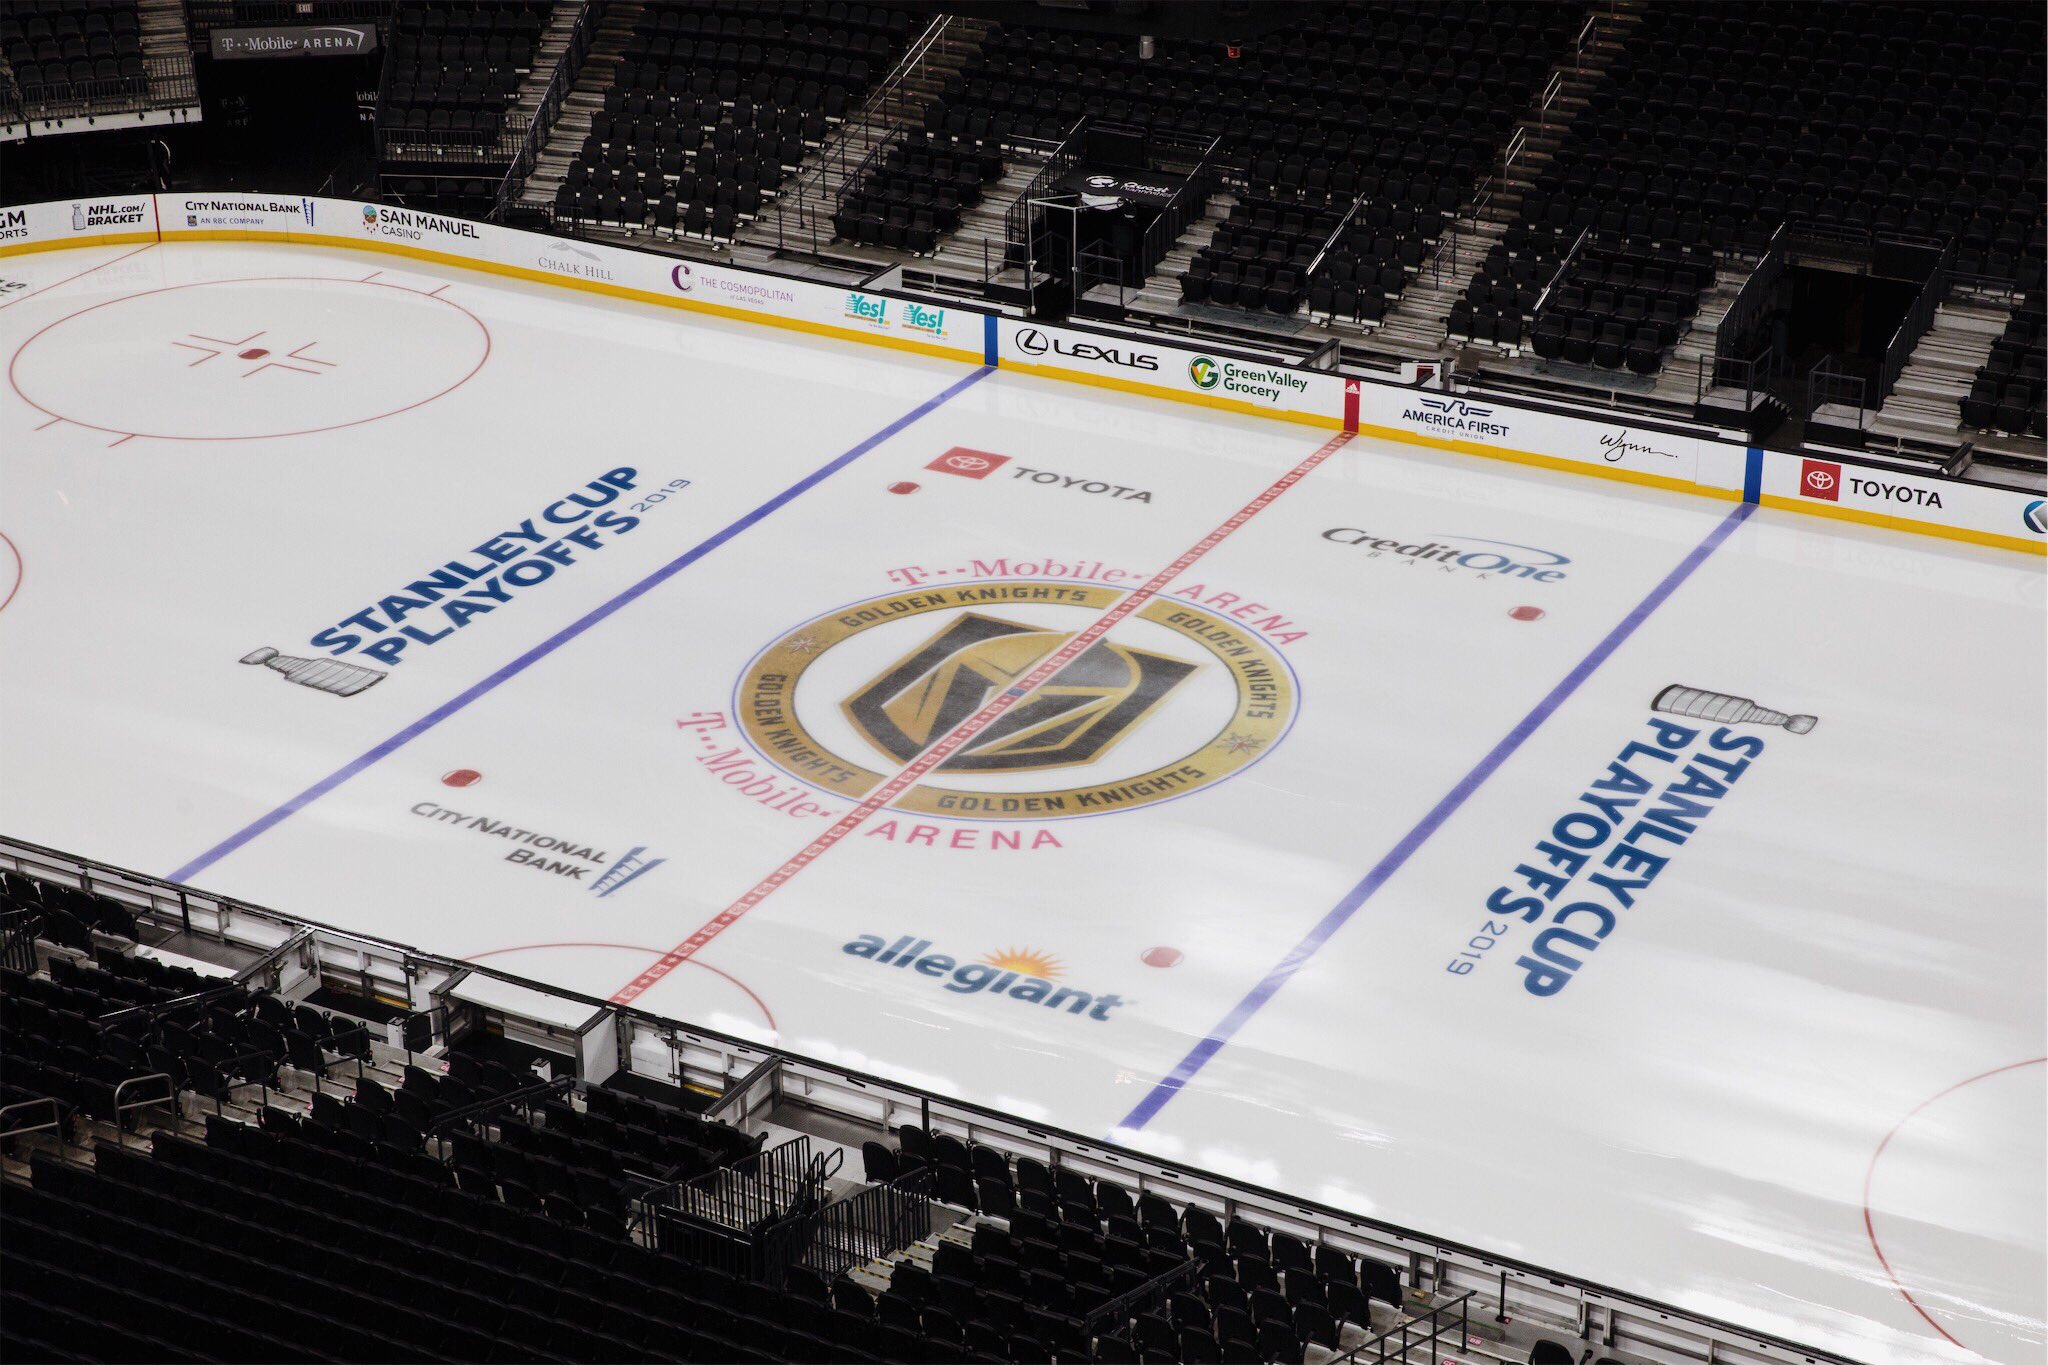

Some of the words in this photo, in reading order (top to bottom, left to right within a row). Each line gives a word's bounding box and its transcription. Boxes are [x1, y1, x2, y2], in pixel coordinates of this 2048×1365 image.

[303, 37, 354, 49] ARENA
[87, 213, 144, 226] BRACKET
[200, 217, 211, 225] AN
[213, 217, 227, 225] RBC
[229, 217, 264, 225] COMPANY
[380, 209, 412, 227] SAN
[416, 214, 480, 239] MANUEL
[381, 225, 421, 241] CASINO
[700, 276, 719, 289] THE
[720, 280, 794, 302] COSMOPOLITAN
[850, 293, 886, 325] Yes!
[908, 304, 944, 335] Yes!
[1053, 339, 1159, 371] LEXUS
[1224, 362, 1266, 382] Green
[1266, 369, 1308, 393] Valley
[1224, 377, 1280, 402] Grocery
[1402, 409, 1465, 430] AMERICA
[1468, 420, 1510, 437] FIRST
[1425, 426, 1455, 435] CREDIT
[1459, 432, 1484, 440] UNION
[1013, 467, 1153, 504] TOYOTA
[1850, 478, 1943, 509] TOYOTA
[309, 518, 548, 656] STANLEY
[542, 466, 639, 525] CUP
[359, 509, 642, 667] PLAYOFFS
[629, 477, 693, 514] 2019
[1366, 551, 1496, 581] BANK
[840, 591, 947, 628] GOLDEN
[956, 587, 1088, 602] KNIGHTS
[1174, 584, 1309, 645] ARENA
[1166, 611, 1253, 657] GOLDEN
[1238, 659, 1278, 719] KNIGHTS
[754, 673, 789, 727] GOLDEN
[764, 728, 857, 784] KNIGHTS
[937, 795, 1065, 812] GOLDEN
[1076, 765, 1206, 807] KNIGHTS
[1485, 717, 1702, 925] PLAYOFFS
[1587, 726, 1765, 911] STANLEY
[864, 820, 1064, 850] ARENA
[1446, 920, 1508, 976] 2019
[1515, 901, 1617, 998] CUP
[841, 933, 1124, 1022] allegiant
